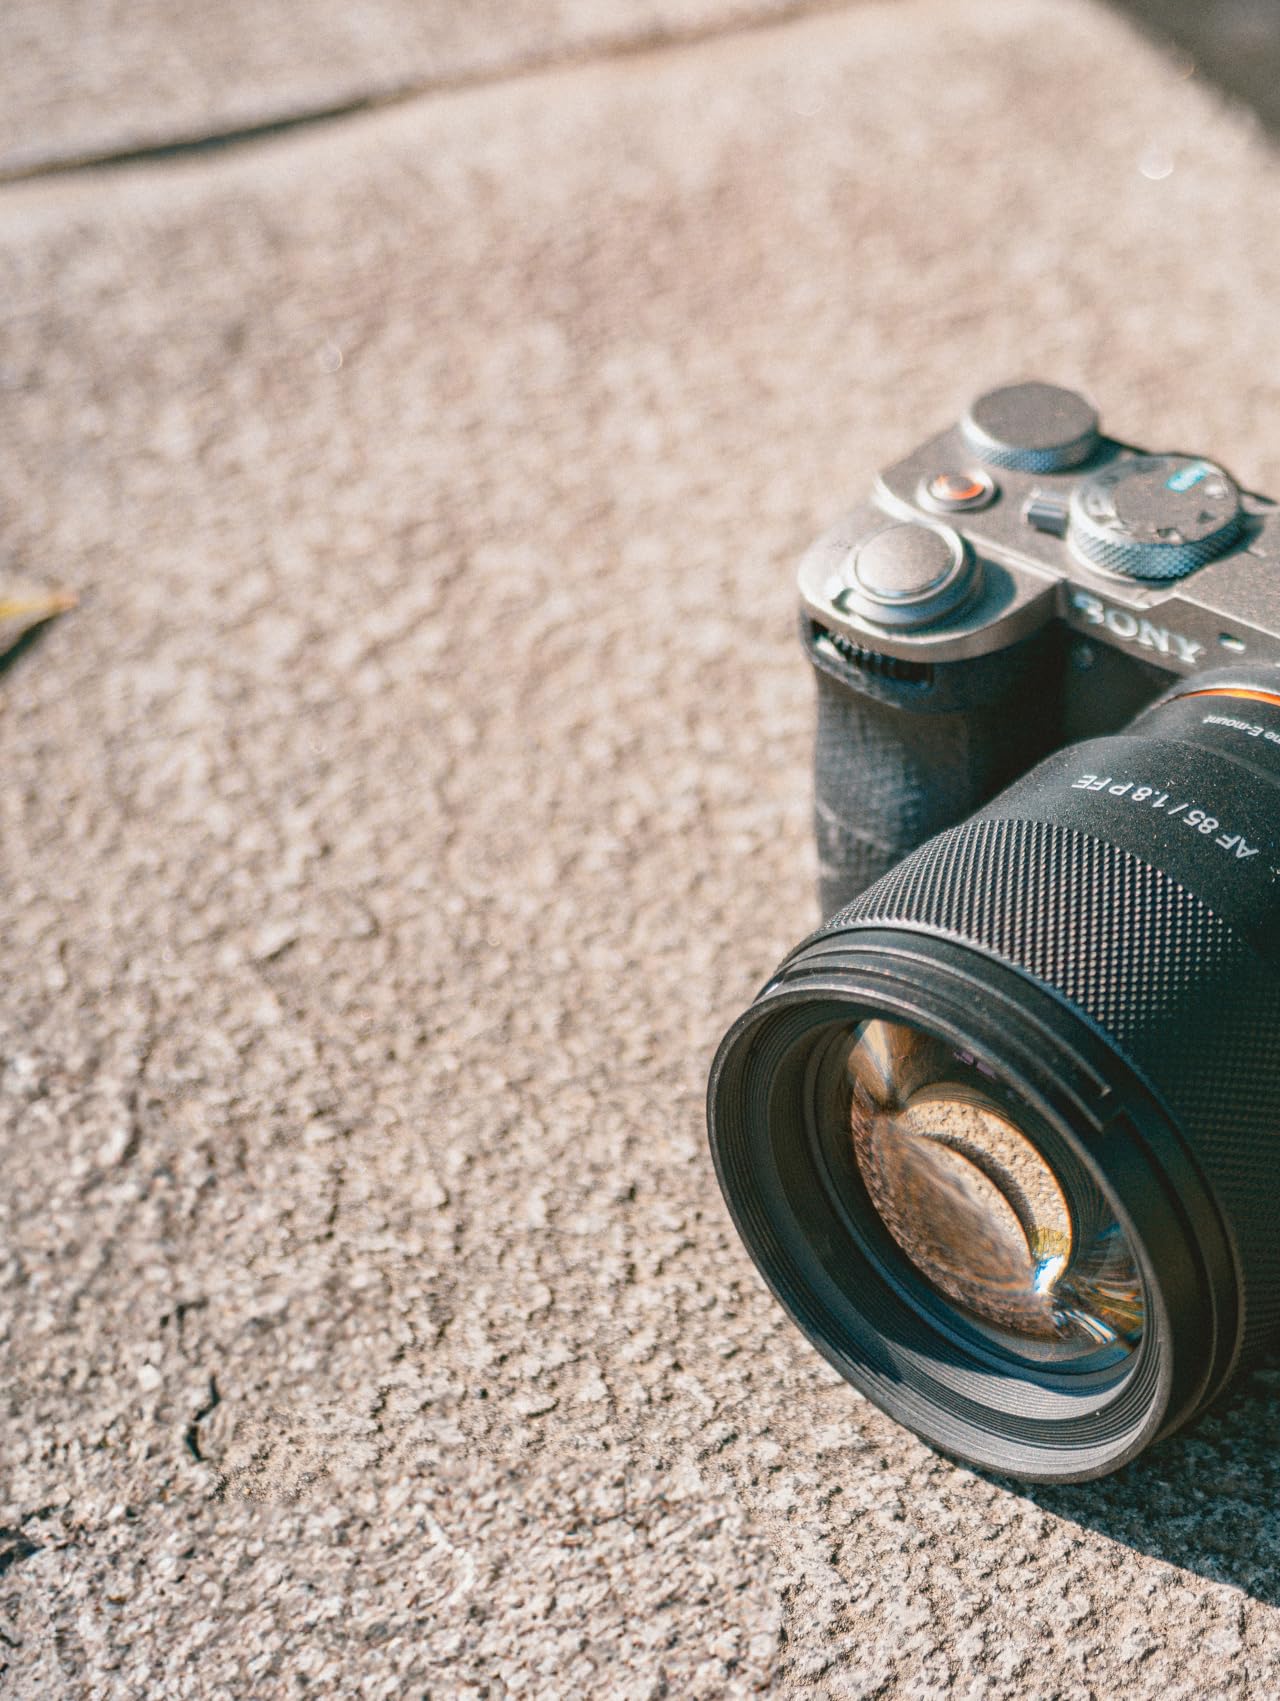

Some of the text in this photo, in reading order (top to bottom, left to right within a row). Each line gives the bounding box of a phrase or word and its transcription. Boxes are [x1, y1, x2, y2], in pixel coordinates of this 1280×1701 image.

[1073, 592, 1204, 664] SONY
[1202, 714, 1264, 737] E-mount
[1071, 774, 1112, 791] FE
[1131, 786, 1169, 808] 1.8
[1215, 834, 1259, 858] AF
